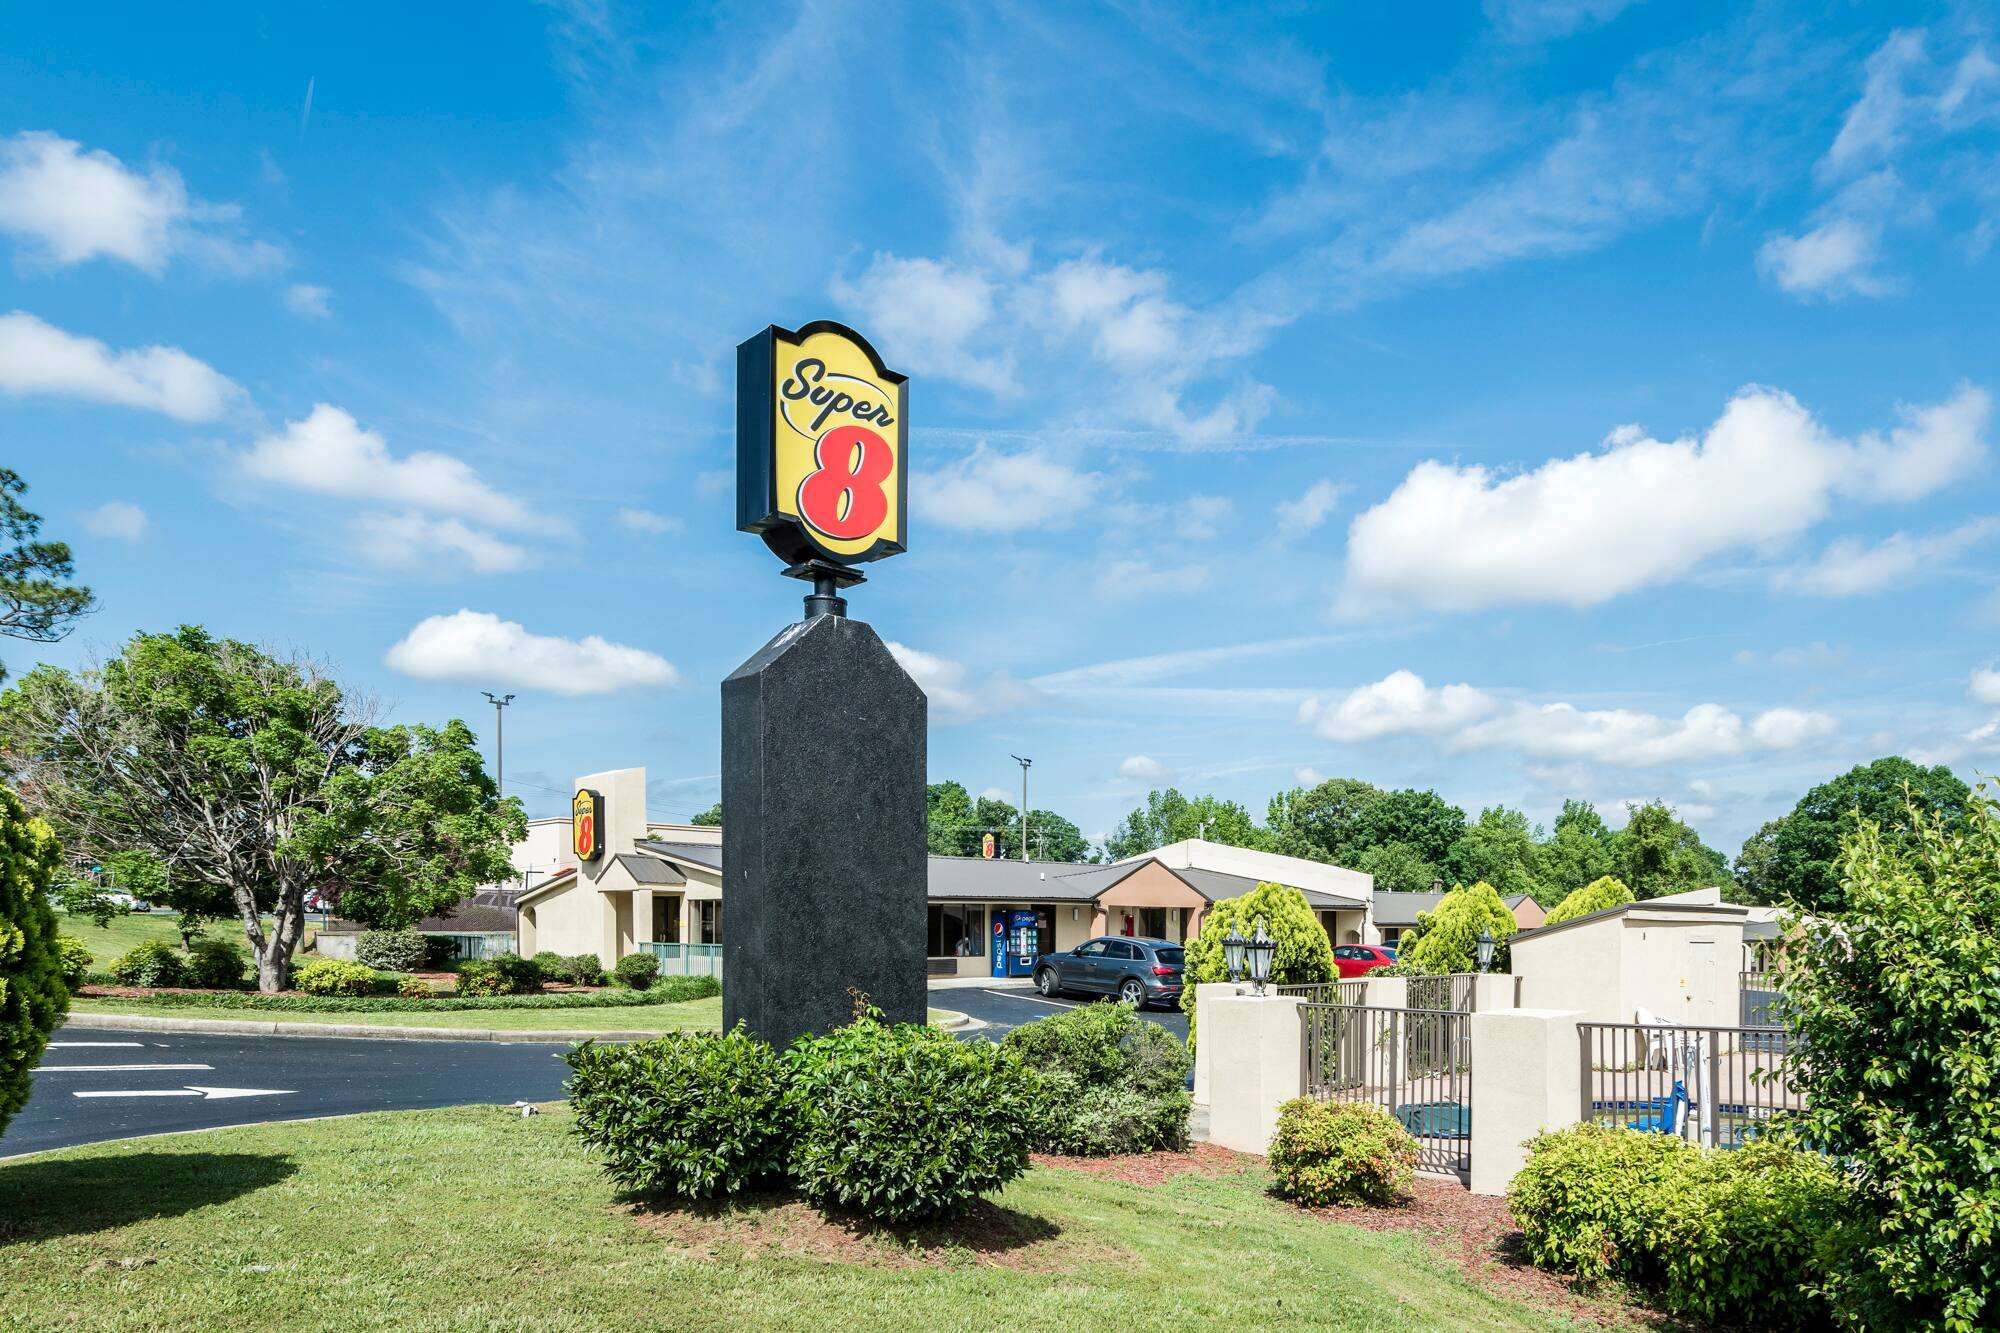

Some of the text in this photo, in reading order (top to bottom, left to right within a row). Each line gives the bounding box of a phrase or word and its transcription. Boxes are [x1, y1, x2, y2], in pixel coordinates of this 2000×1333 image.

[782, 358, 895, 431] Super
[796, 426, 893, 541] 8
[576, 801, 592, 822] Super
[579, 816, 592, 855] 8
